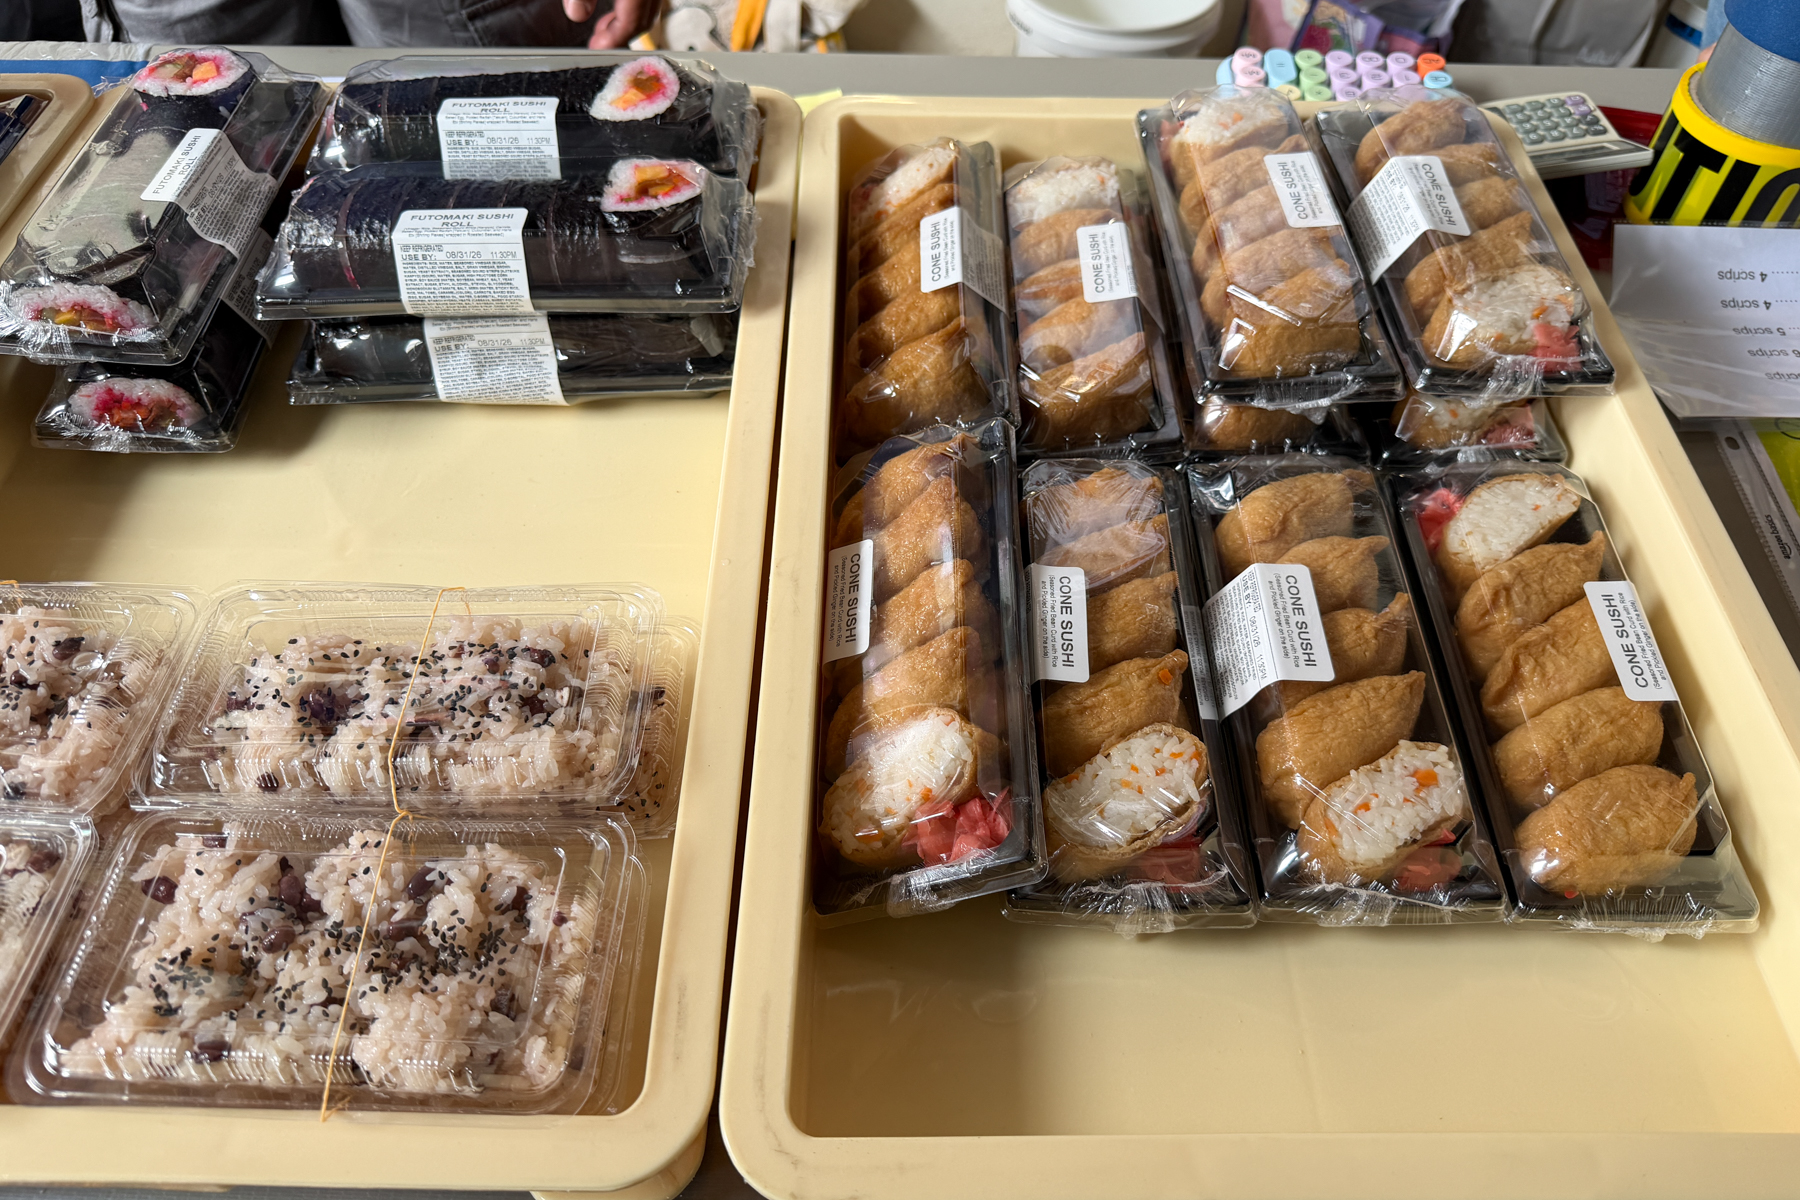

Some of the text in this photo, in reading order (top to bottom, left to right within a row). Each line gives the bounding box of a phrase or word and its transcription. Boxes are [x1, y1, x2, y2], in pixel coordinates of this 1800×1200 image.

[152, 157, 185, 194] FUTOMAKI
[180, 135, 201, 156] SUSHI
[177, 156, 197, 175] ROLL
[1276, 161, 1297, 188] SUSHI
[1420, 163, 1442, 191] CONE
[1434, 193, 1456, 226] SUSHI
[1288, 191, 1309, 219] CONE
[930, 220, 941, 282] CONE SUSHI
[1088, 233, 1105, 293] CONE SUSHI
[1718, 268, 1768, 283] 4 scrips
[1720, 298, 1772, 311] 4 scrips
[1732, 326, 1786, 337] 5 scrips
[1747, 348, 1789, 359] scrips
[1764, 514, 1791, 560] amazon basics
[1241, 574, 1249, 593] USE
[845, 552, 860, 643] CONE SUSHI
[1270, 591, 1279, 608] Pickled
[1616, 592, 1626, 603] Rice
[1280, 601, 1288, 613] Fried
[1621, 605, 1631, 614] with
[1058, 576, 1074, 667] CONE SUSHI
[1273, 610, 1283, 627] Ginger
[1283, 614, 1291, 628] Bean
[1284, 575, 1316, 666] CONE SUSHI
[1625, 616, 1636, 628] Curd
[1633, 613, 1642, 621] the
[1286, 629, 1294, 642] Curd
[1599, 594, 1650, 687] CONE SUSHI
[1631, 630, 1642, 643] Bean
[1640, 630, 1654, 647] Ginger
[1289, 643, 1297, 654] with
[1637, 645, 1649, 658] Fried
[1292, 655, 1300, 667] Rice
[1648, 649, 1662, 668] Pickled
[1657, 669, 1666, 680] and
